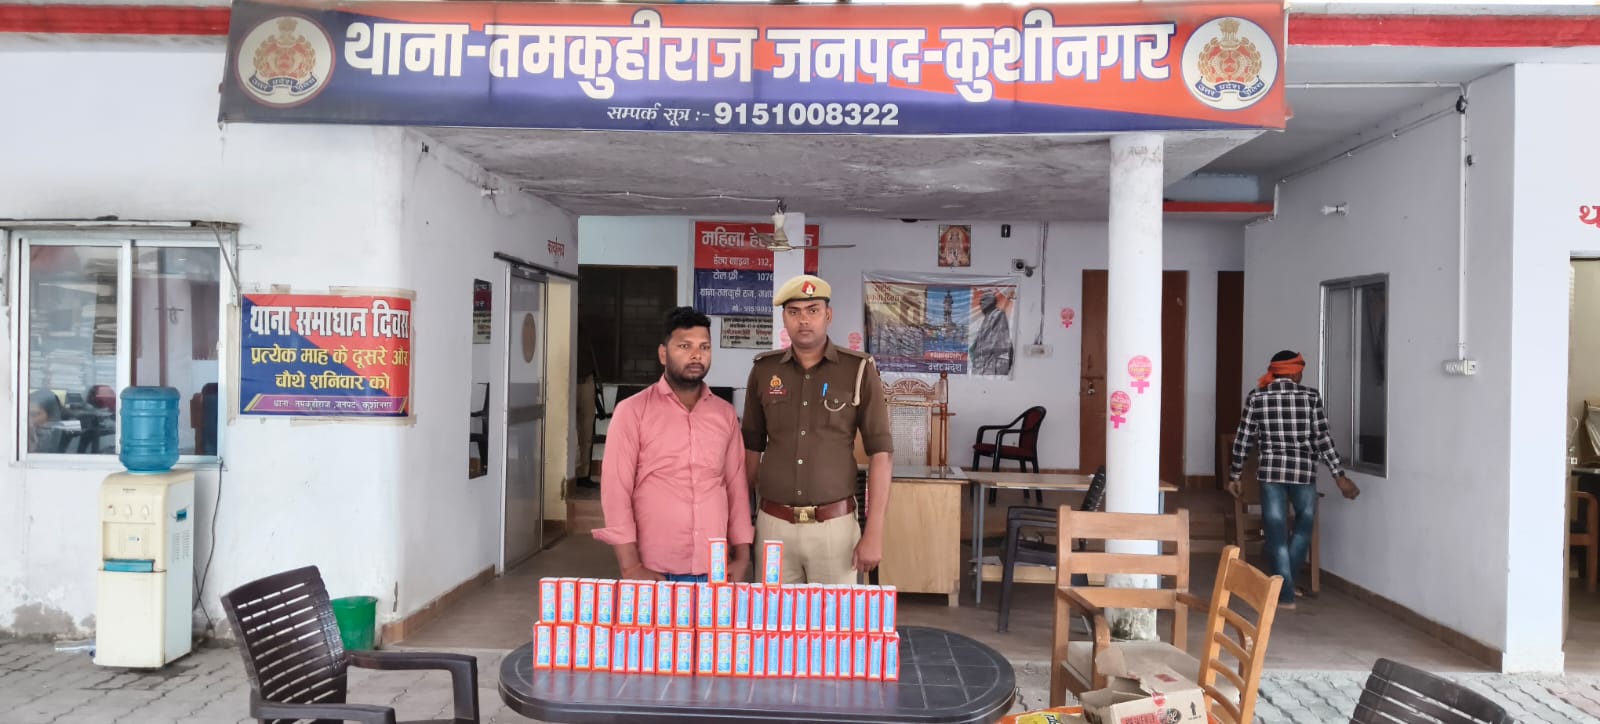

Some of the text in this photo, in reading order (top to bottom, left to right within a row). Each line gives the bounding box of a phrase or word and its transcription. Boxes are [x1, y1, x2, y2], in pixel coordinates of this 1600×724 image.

[344, 9, 1175, 102] थाना-तमकुहीराज जनपद-कुशीनगर
[606, 103, 661, 120] सम्पर्क
[663, 108, 691, 126] सूत्र
[714, 102, 899, 126] 9151008322
[701, 226, 745, 248] महिला
[250, 306, 292, 336] थाना
[295, 306, 368, 337] समाधान
[250, 343, 409, 369] प्रत्येक माह के दूसरे और
[275, 370, 391, 390] चौथे शनिवार को
